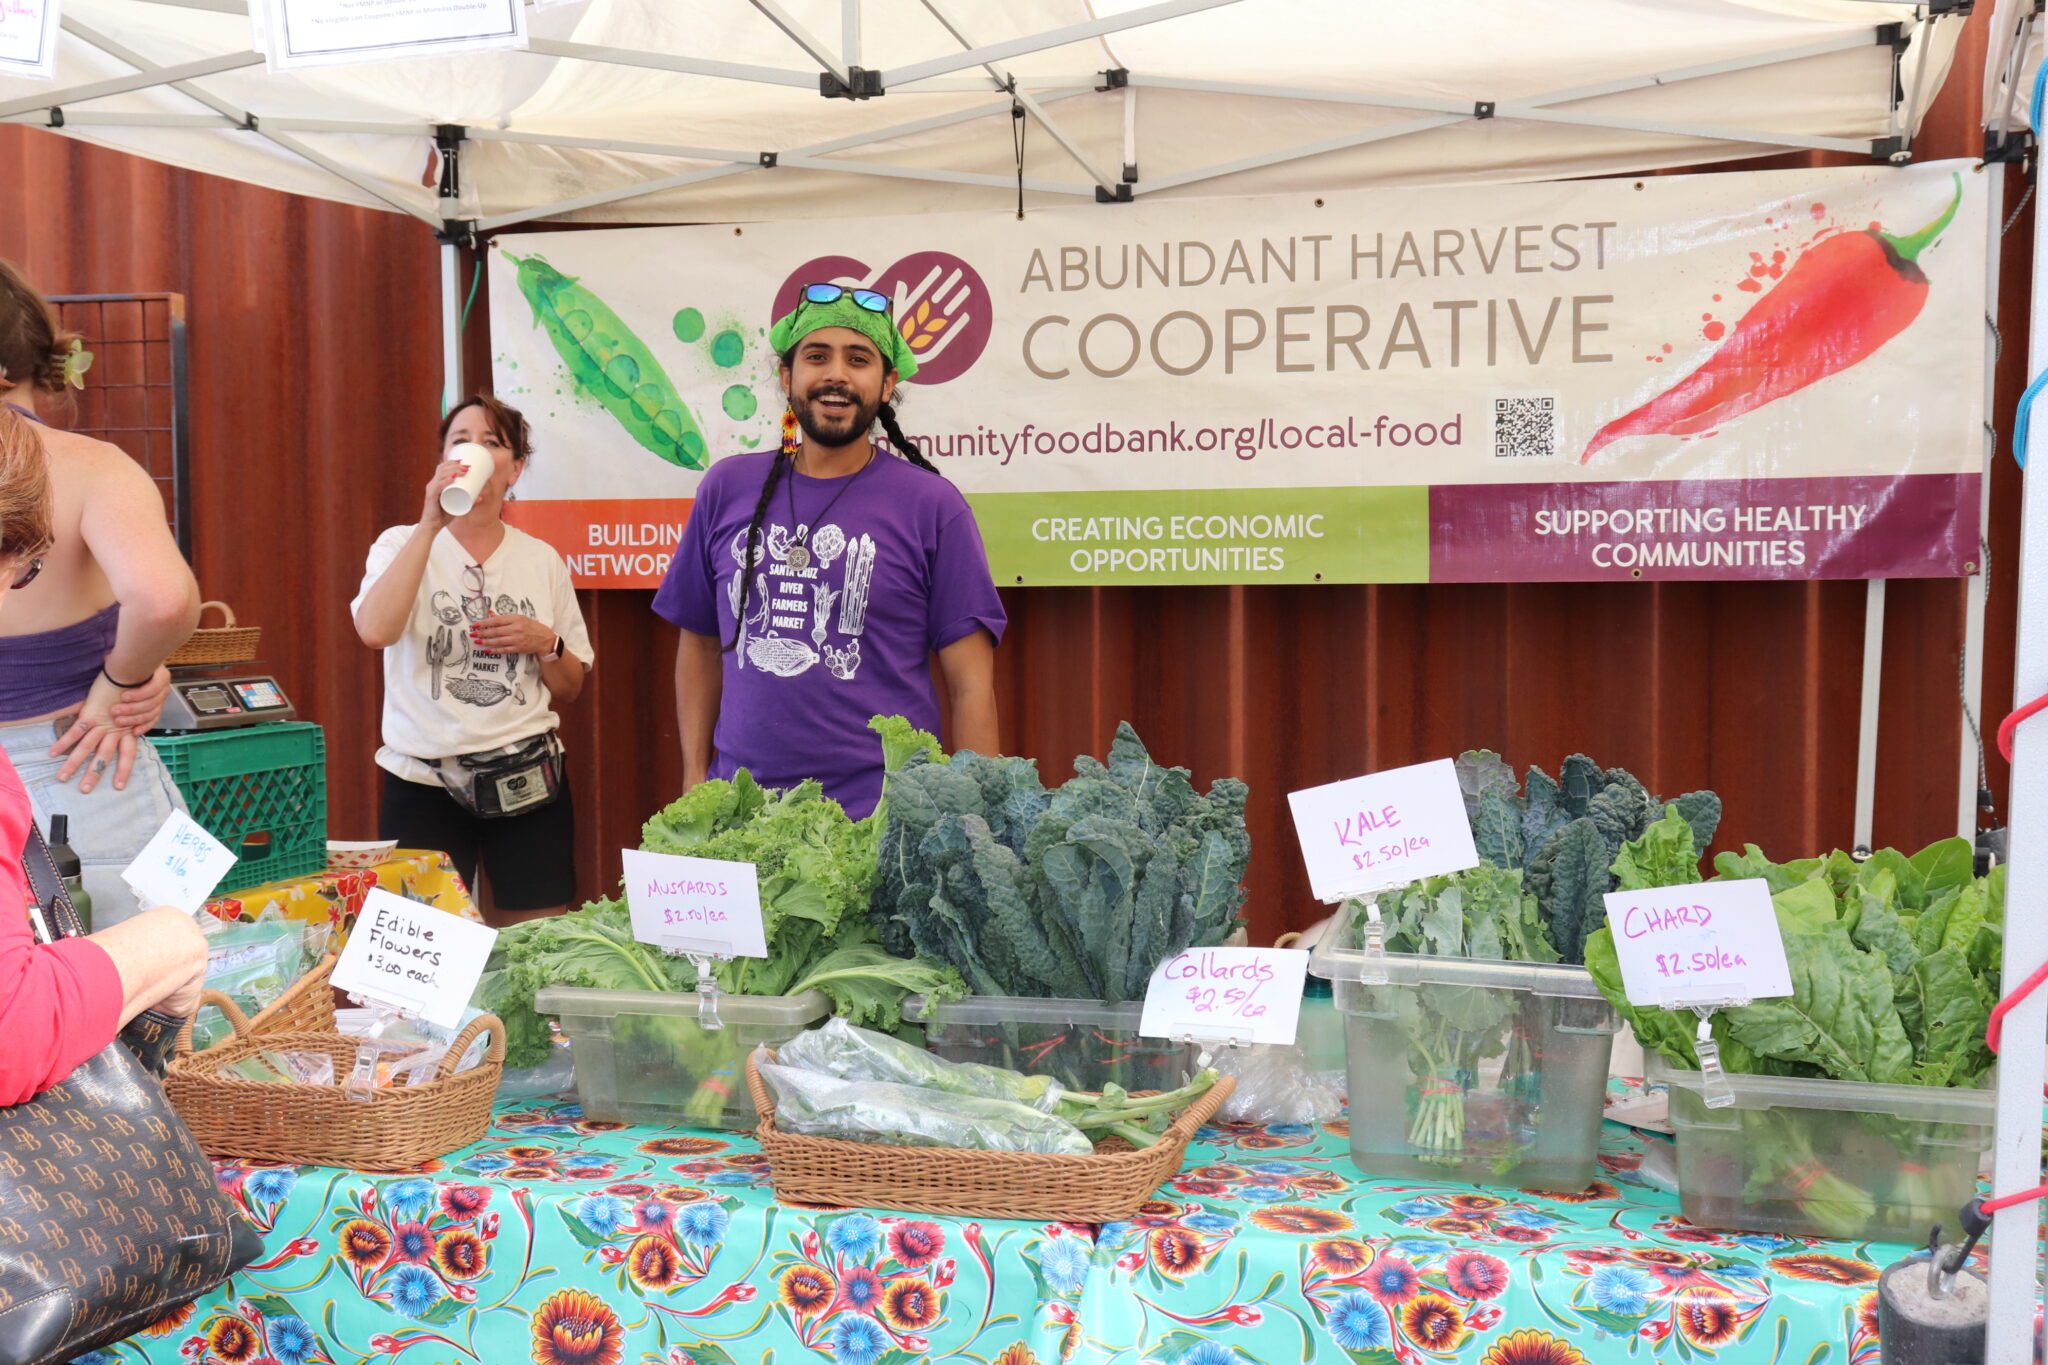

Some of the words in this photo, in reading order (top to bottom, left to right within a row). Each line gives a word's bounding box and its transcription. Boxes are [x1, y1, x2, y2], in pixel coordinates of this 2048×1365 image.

[1020, 235, 1332, 293] ABUNDANT
[1351, 222, 1617, 280] HARVEST
[1022, 295, 1614, 380] COOPERATIVE
[874, 413, 1462, 466] mmunityfoodbank.org/local-food
[1032, 516, 1164, 542] CREATING
[1170, 514, 1324, 540] ECONOMIC
[1534, 508, 1726, 535] SUPPORTING
[1735, 504, 1867, 532] HEALTHY
[588, 524, 682, 546] BUILDIN
[566, 554, 674, 576] NETWOR
[1070, 547, 1284, 572] OPPORTUNITIES
[1592, 540, 1806, 568] COMMUNITIES
[769, 564, 795, 577] SANTA
[780, 582, 804, 595] RIVER
[772, 598, 808, 613] FARMERS
[772, 615, 804, 630] MARKET
[472, 662, 500, 672] MARKET
[1334, 805, 1402, 846] KALE
[171, 824, 212, 862] HERBS
[1352, 836, 1430, 870] $2.50/ea
[648, 879, 728, 898] MUSTARDS
[375, 909, 435, 942] Edible
[664, 906, 728, 925] $2.50/ea
[1624, 904, 1712, 938] CHARD
[370, 928, 442, 966] Flowers
[1656, 945, 1747, 977] $2.50/ea
[406, 969, 440, 988] each
[1164, 952, 1274, 982] Collards
